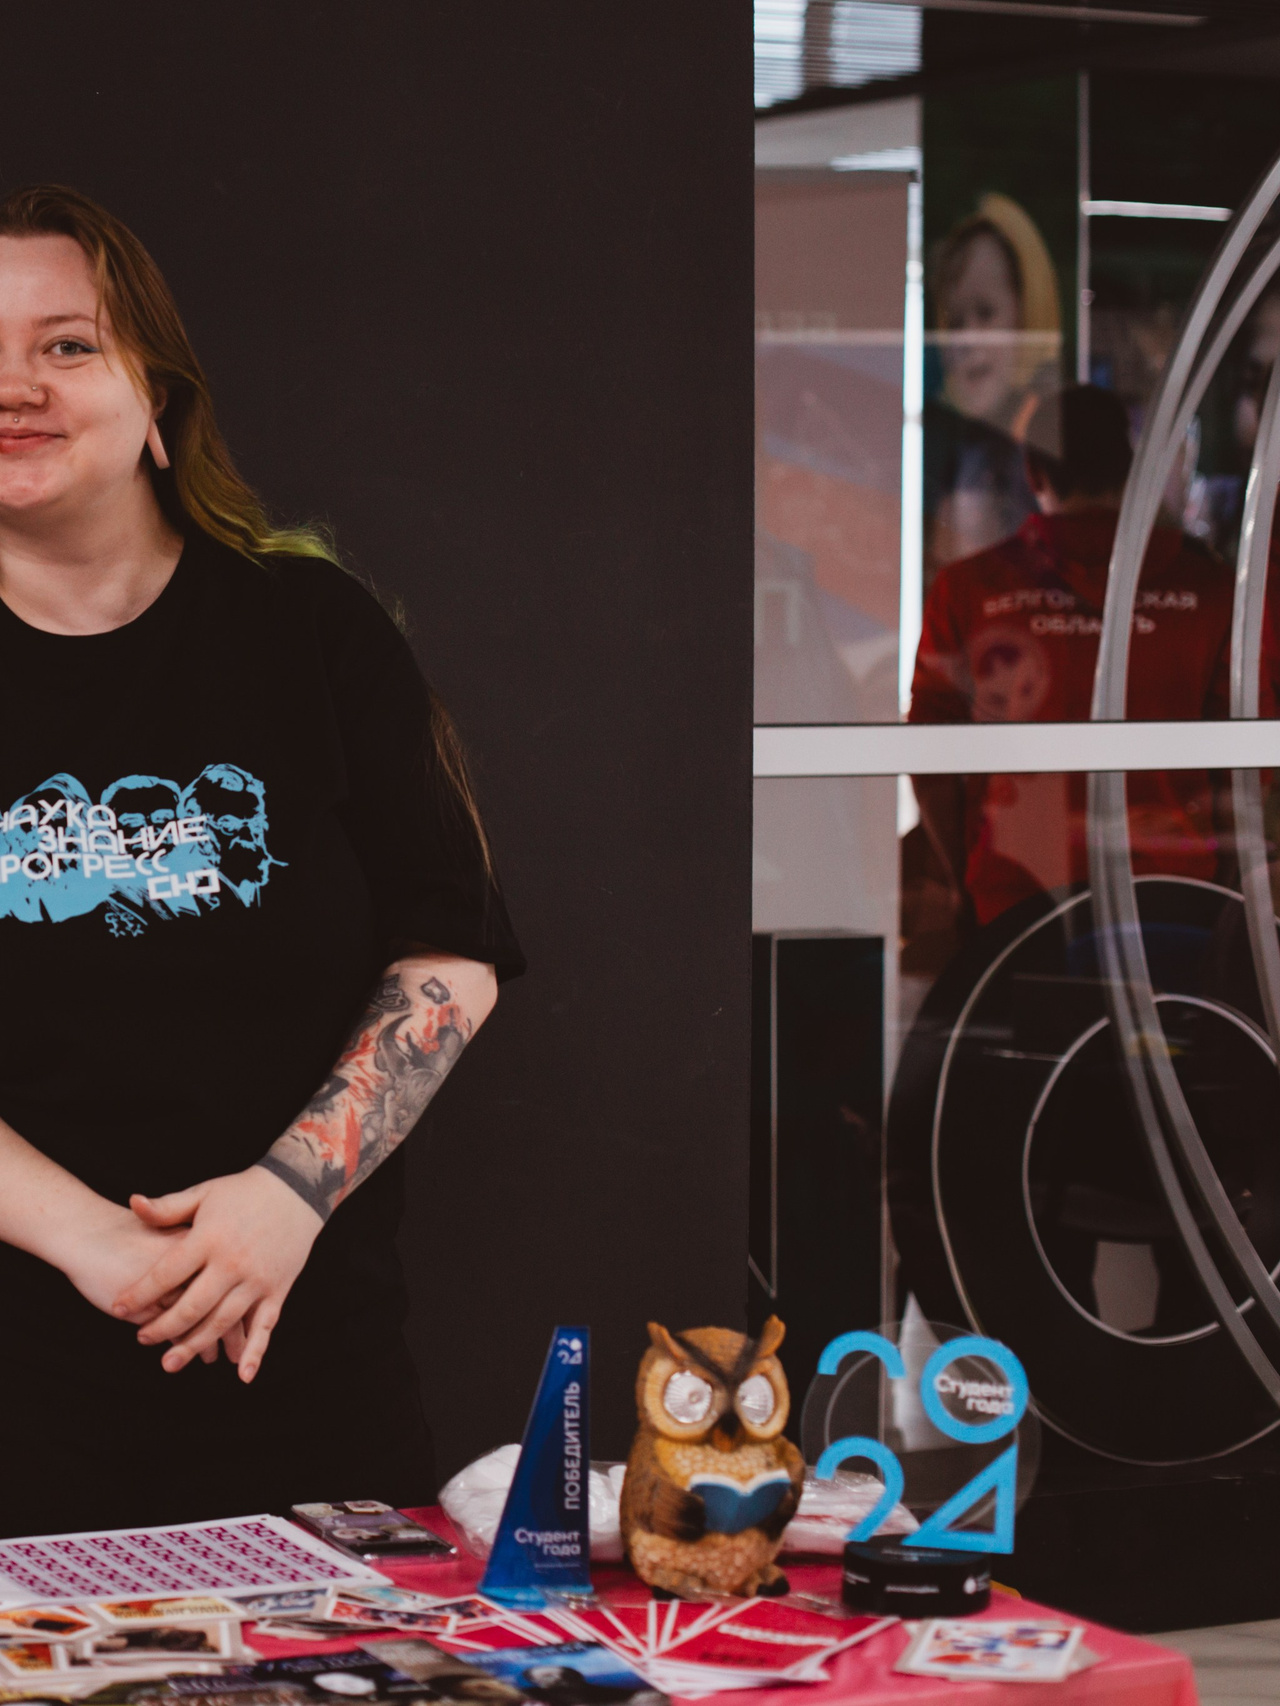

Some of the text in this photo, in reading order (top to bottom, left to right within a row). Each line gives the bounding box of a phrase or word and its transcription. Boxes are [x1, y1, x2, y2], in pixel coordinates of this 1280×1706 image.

[37, 815, 210, 855] ЗНАНИЕ
[933, 1373, 1015, 1400] Студент
[965, 1397, 1015, 1416] года
[564, 1381, 581, 1510] ПОБЕДИТЕЛЬ
[514, 1527, 581, 1547] Студент
[542, 1541, 581, 1556] года
